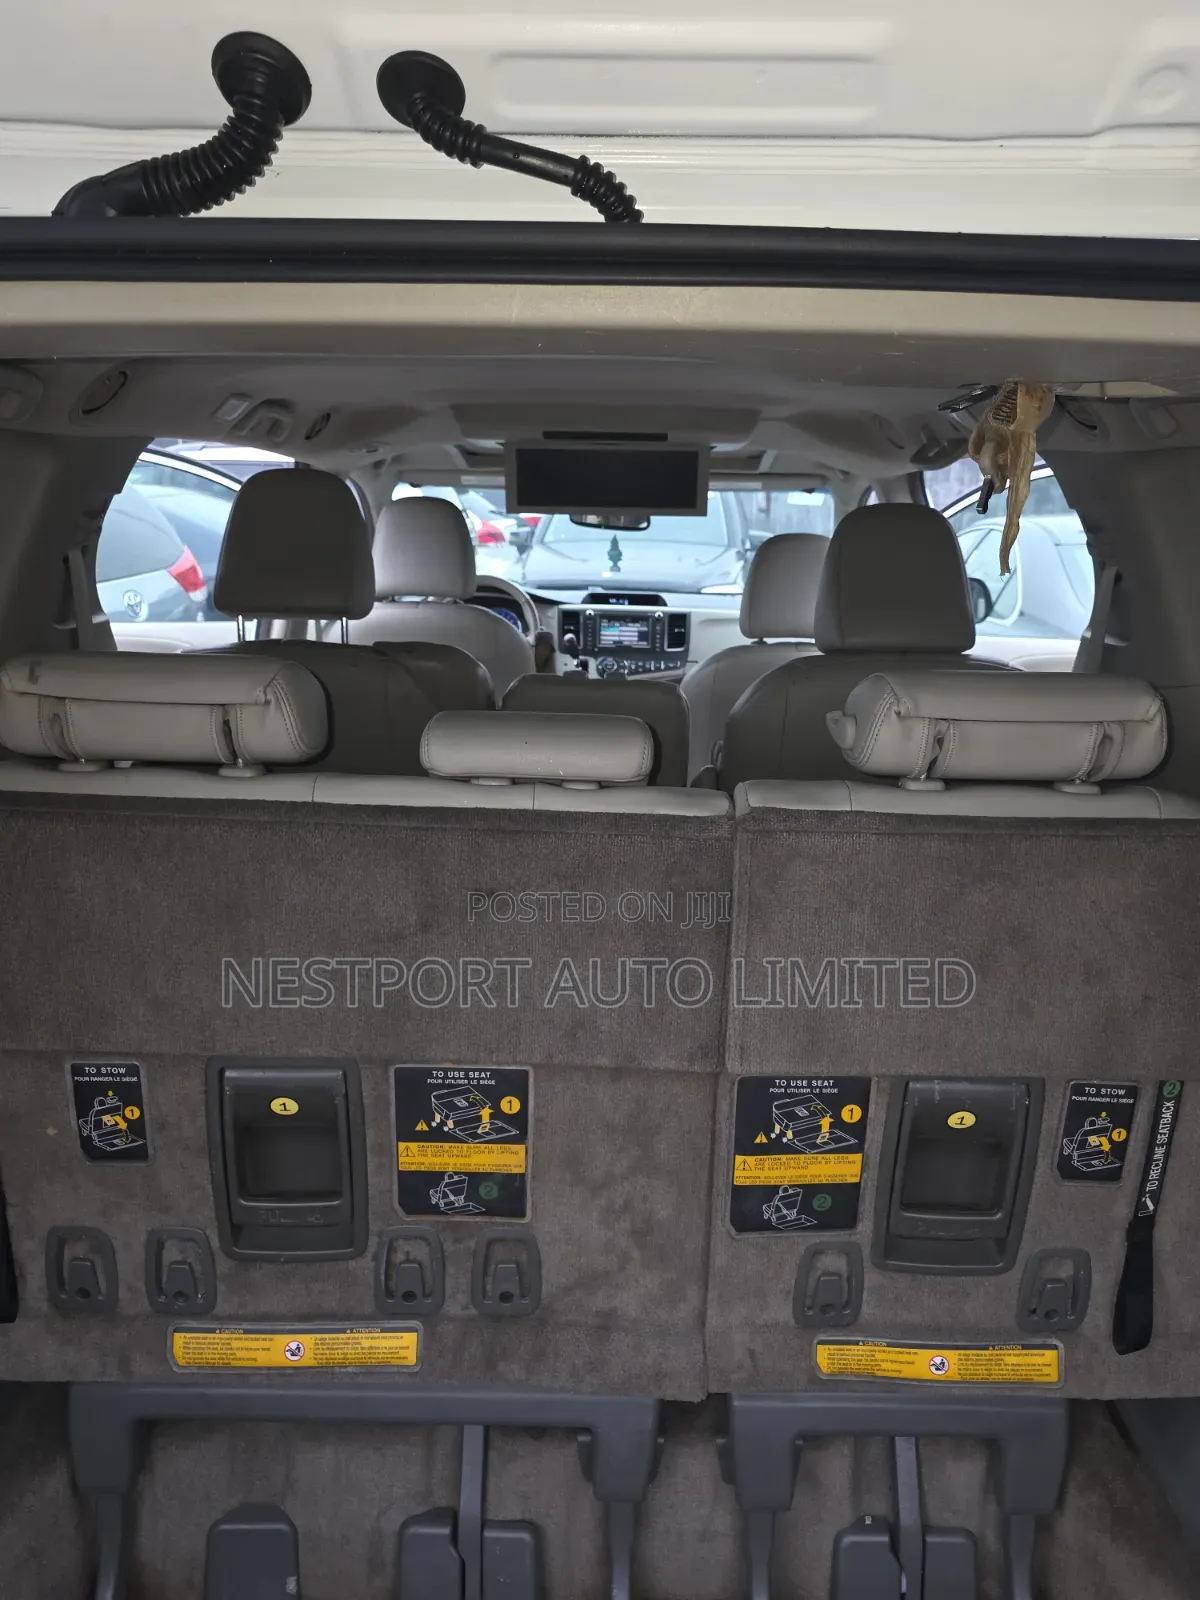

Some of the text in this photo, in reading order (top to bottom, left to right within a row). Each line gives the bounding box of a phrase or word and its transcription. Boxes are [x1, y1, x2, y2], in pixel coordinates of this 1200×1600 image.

[775, 1079, 834, 1087] TO USE SEAT
[1168, 1083, 1176, 1095] 2
[279, 1102, 291, 1112] 1
[507, 1099, 512, 1111] 1
[847, 1107, 854, 1120] 1
[954, 1116, 966, 1126] 1
[1146, 1100, 1175, 1192] TO RECLINE SEATBACK
[484, 1185, 493, 1195] 2
[817, 1197, 827, 1209] 2
